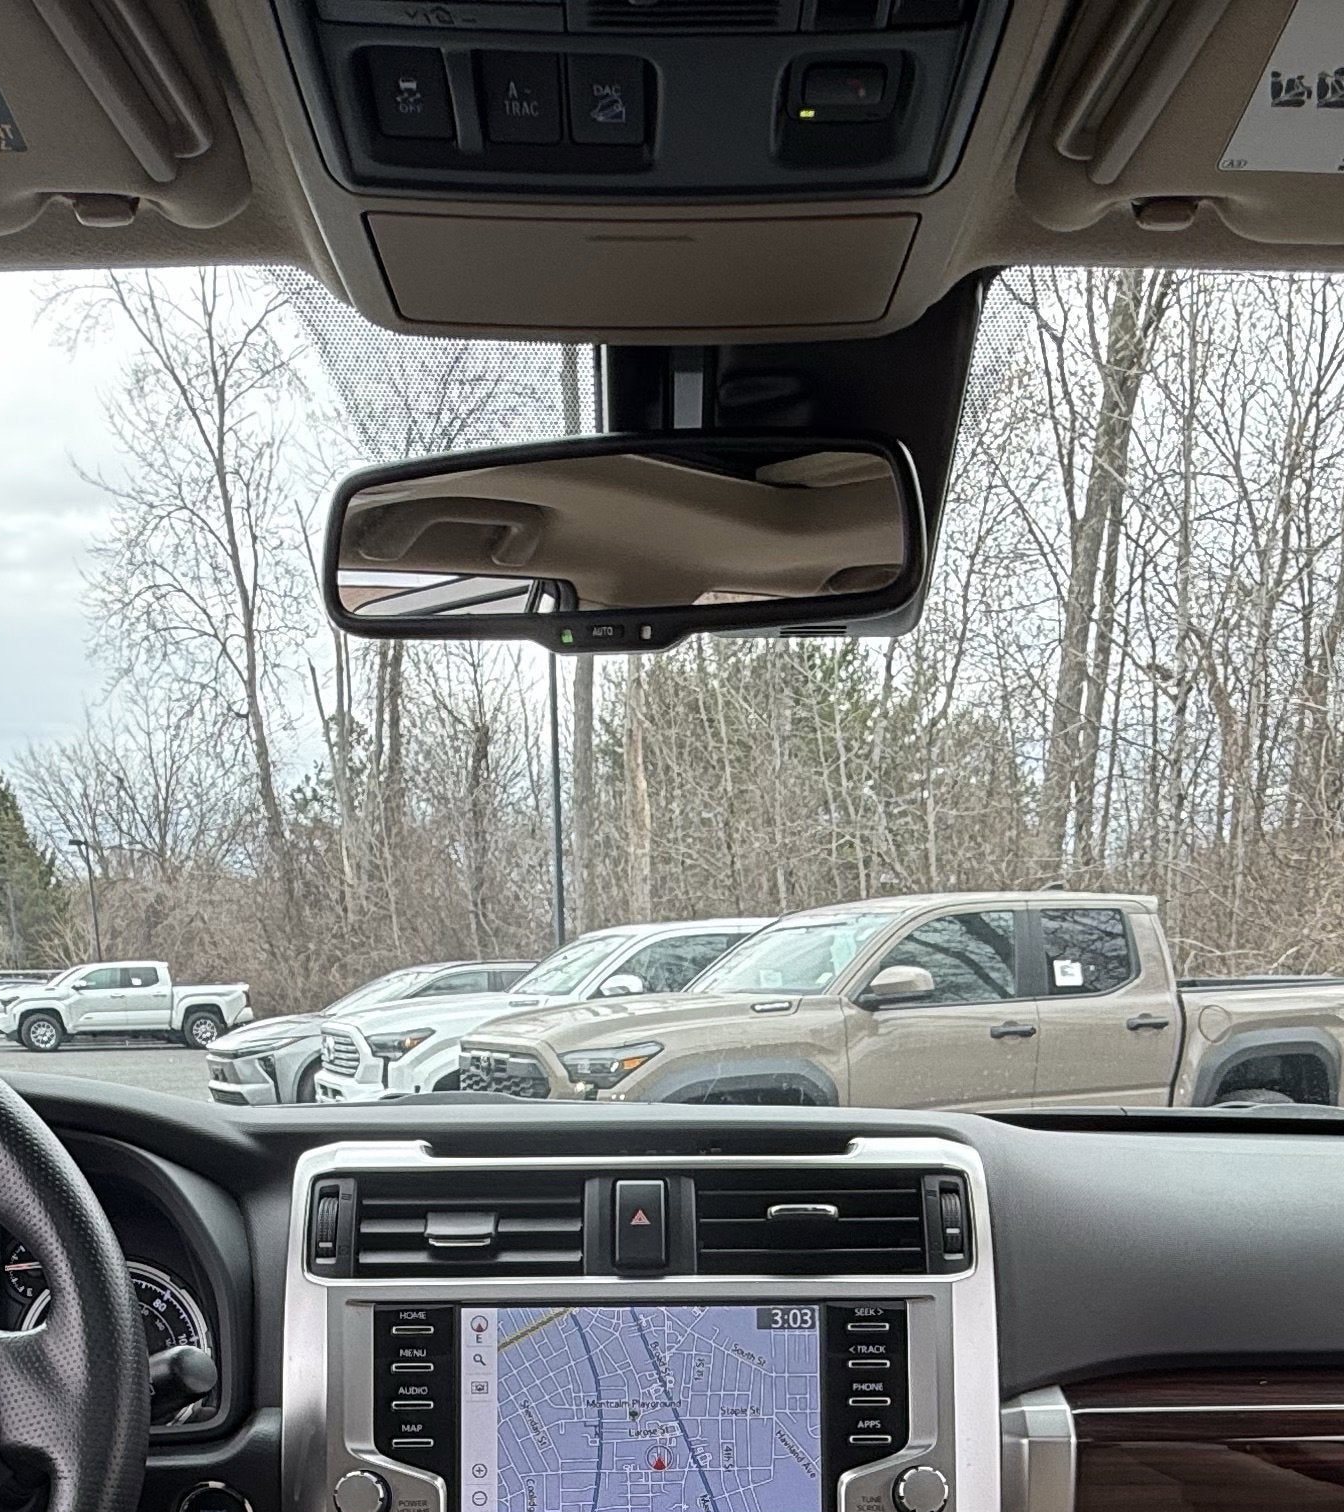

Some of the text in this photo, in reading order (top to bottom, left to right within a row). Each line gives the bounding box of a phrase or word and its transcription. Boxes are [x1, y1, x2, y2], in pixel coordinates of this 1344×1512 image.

[593, 84, 621, 96] DAC
[503, 101, 539, 117] TRAC
[592, 627, 614, 637] AUTO
[152, 1298, 167, 1313] 80
[399, 1311, 427, 1320] HOME
[854, 1307, 876, 1316] SEEK
[771, 1309, 813, 1328] 3:03
[476, 1335, 483, 1344] E
[399, 1349, 427, 1358] MENU
[857, 1345, 886, 1354] TRACK
[732, 1343, 767, 1367] South St
[398, 1386, 428, 1395] AUDIO
[852, 1383, 883, 1391] PHONE
[586, 1399, 681, 1411] Montcalm Playground
[720, 1406, 760, 1417] Staple St
[401, 1424, 423, 1433] MAP
[857, 1420, 881, 1429] APPS
[722, 1446, 732, 1474] 4th St
[800, 1462, 817, 1479] Ave
